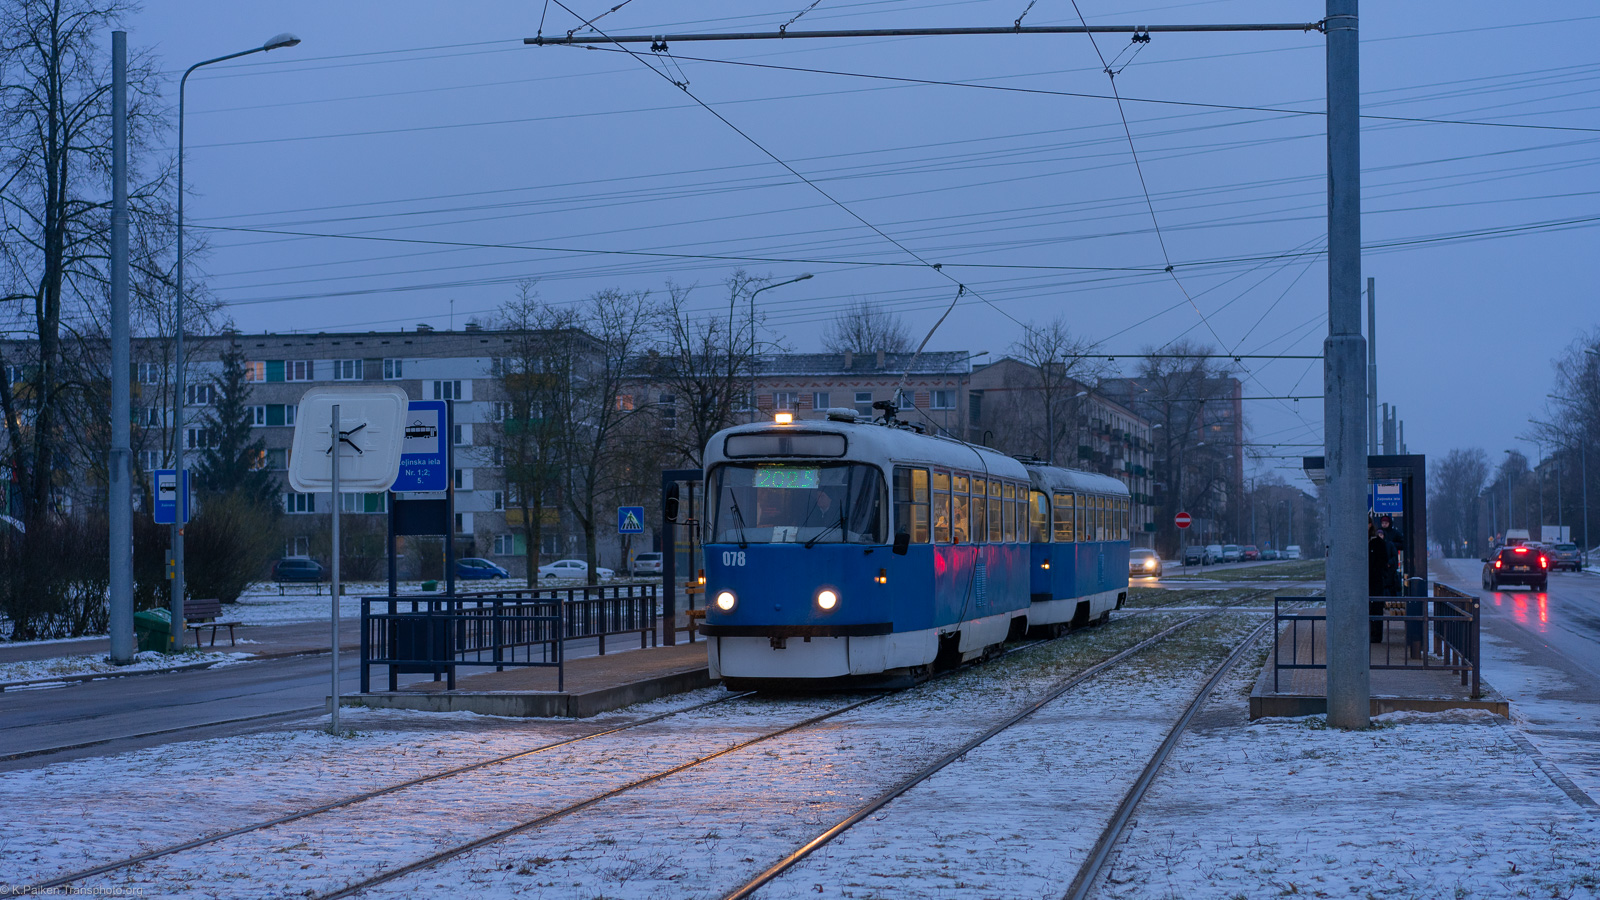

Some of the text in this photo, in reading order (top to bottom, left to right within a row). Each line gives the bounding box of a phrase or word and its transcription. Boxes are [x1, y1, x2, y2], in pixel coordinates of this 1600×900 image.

[758, 470, 812, 488] 2025
[782, 529, 788, 542] 1
[722, 551, 746, 566] 078
